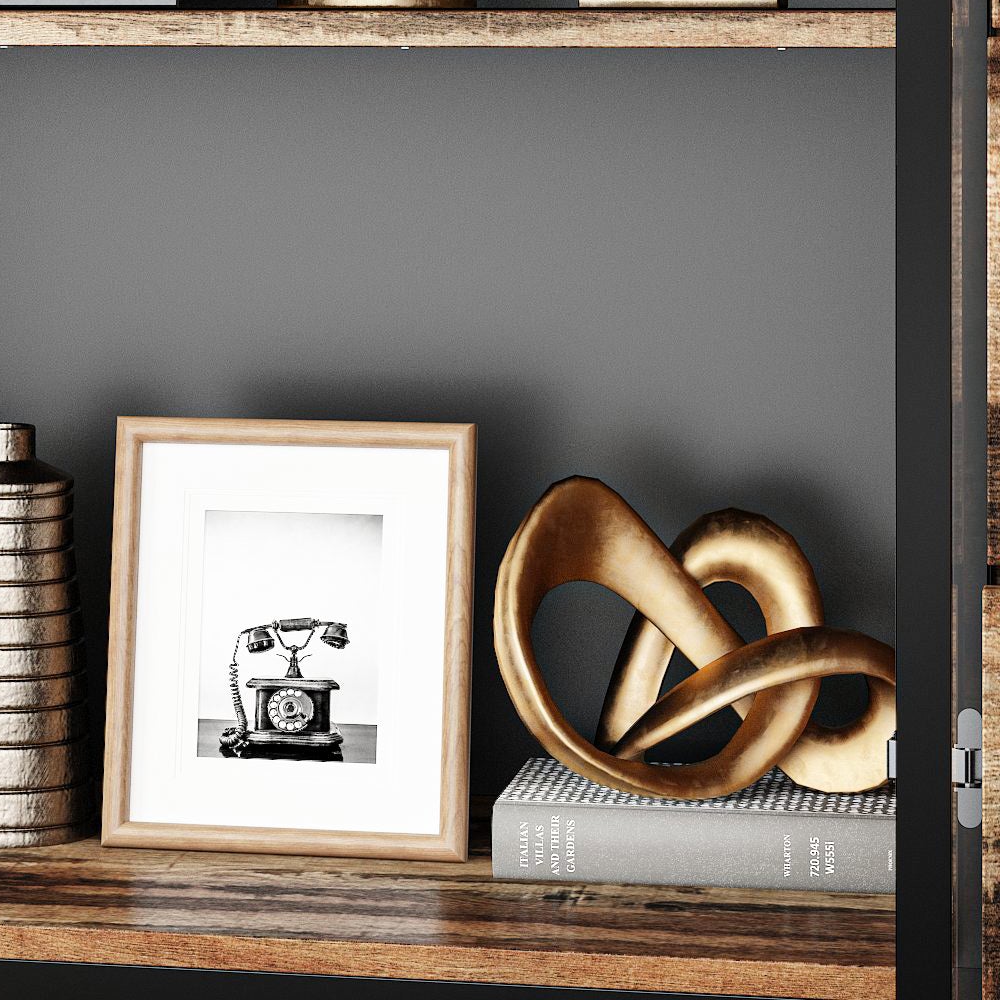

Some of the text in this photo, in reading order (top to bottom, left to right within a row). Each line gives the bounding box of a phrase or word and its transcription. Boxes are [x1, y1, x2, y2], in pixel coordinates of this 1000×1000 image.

[519, 821, 529, 868] ITALIAN
[535, 824, 544, 866] VILLAS
[550, 814, 560, 876] AND THEIR
[566, 819, 576, 873] GARDENS
[783, 834, 791, 878] WHARTON
[809, 836, 820, 878] 720.945
